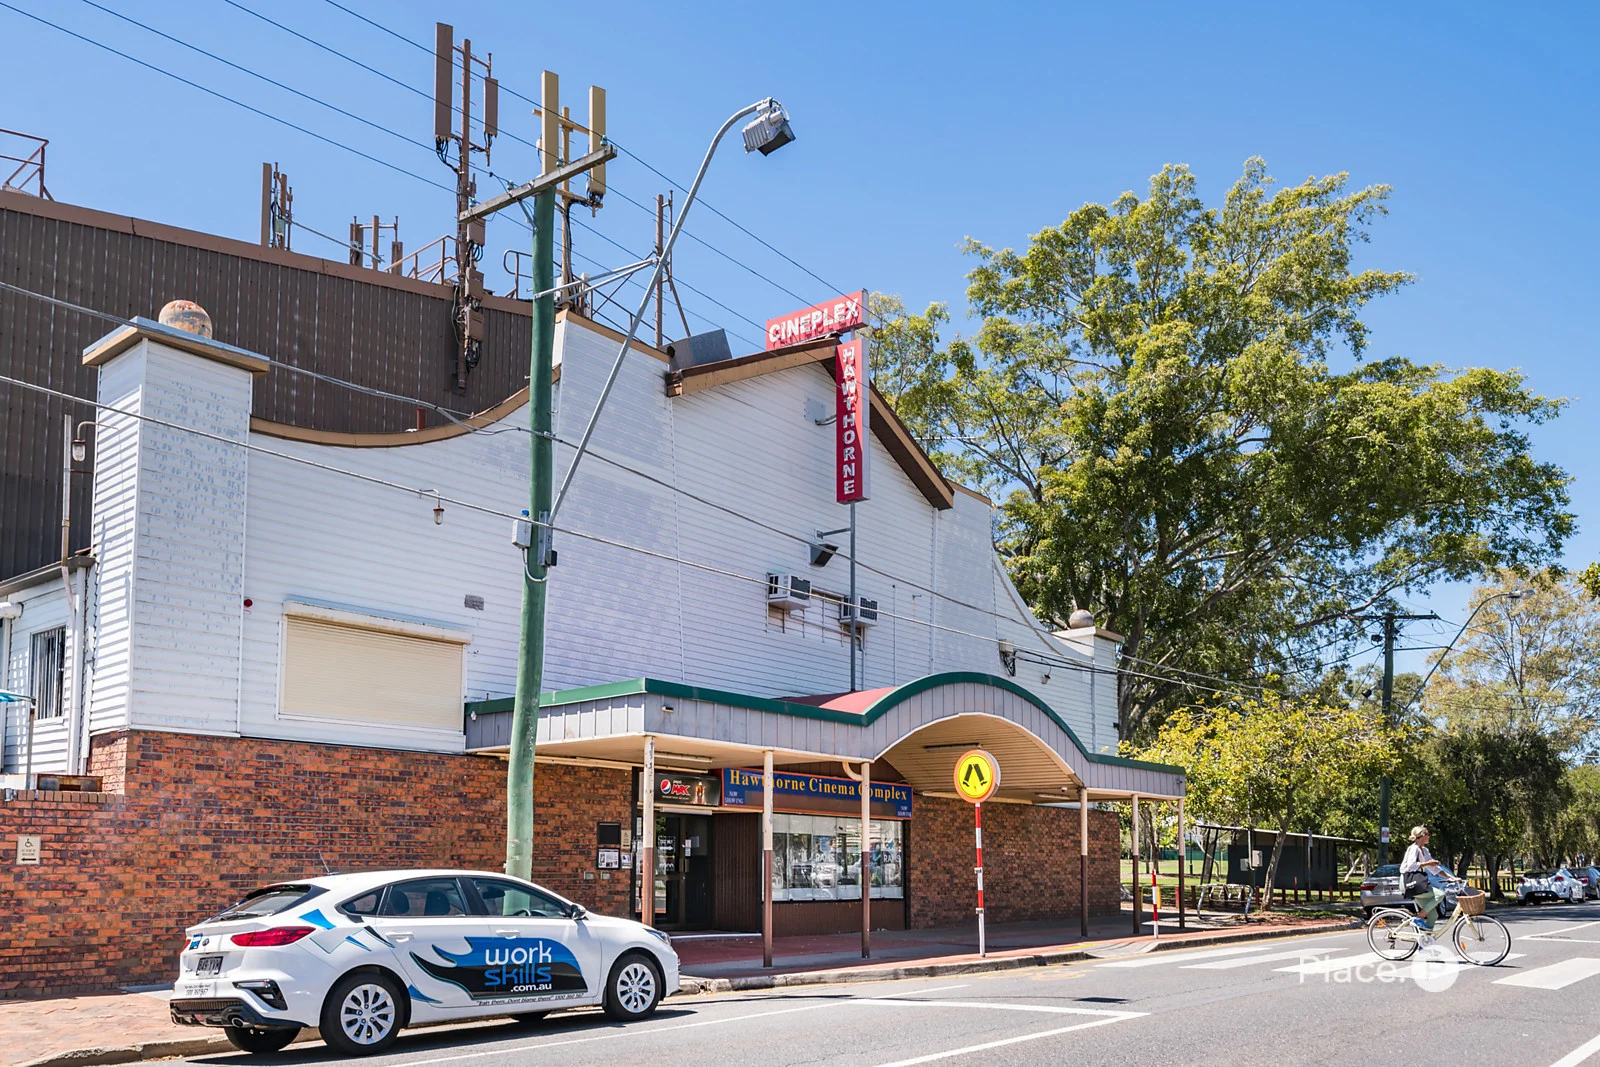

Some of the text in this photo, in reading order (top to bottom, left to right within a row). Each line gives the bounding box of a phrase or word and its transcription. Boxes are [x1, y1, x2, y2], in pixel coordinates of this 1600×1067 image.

[768, 298, 859, 343] CINEPLEX
[841, 346, 857, 494] HAWTHORNE
[730, 769, 805, 790] Haworne
[809, 777, 855, 796] Cinema
[485, 940, 553, 966] work
[484, 963, 553, 986] skills
[510, 983, 553, 993] .com.au
